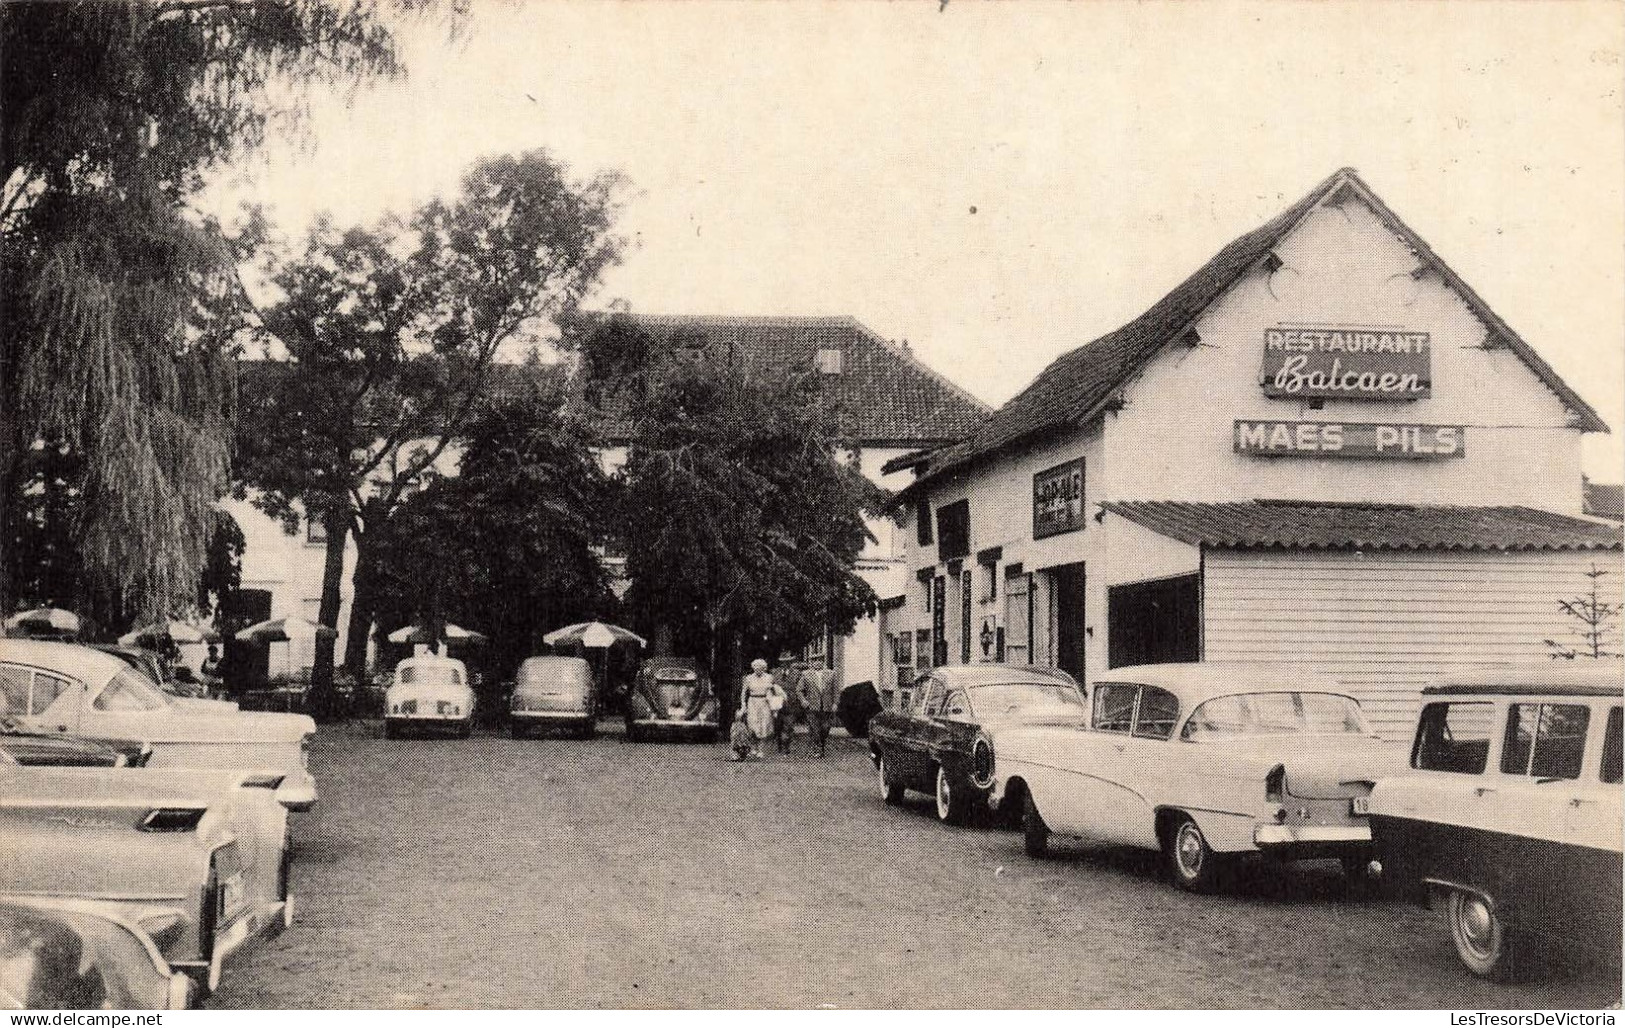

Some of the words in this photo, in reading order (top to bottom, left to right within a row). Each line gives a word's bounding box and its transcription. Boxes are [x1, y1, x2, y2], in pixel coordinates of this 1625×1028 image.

[1267, 332, 1428, 354] RESTAURANT
[1274, 354, 1425, 394] Balcaen
[1239, 423, 1344, 451] MAES
[1375, 426, 1458, 455] PILS
